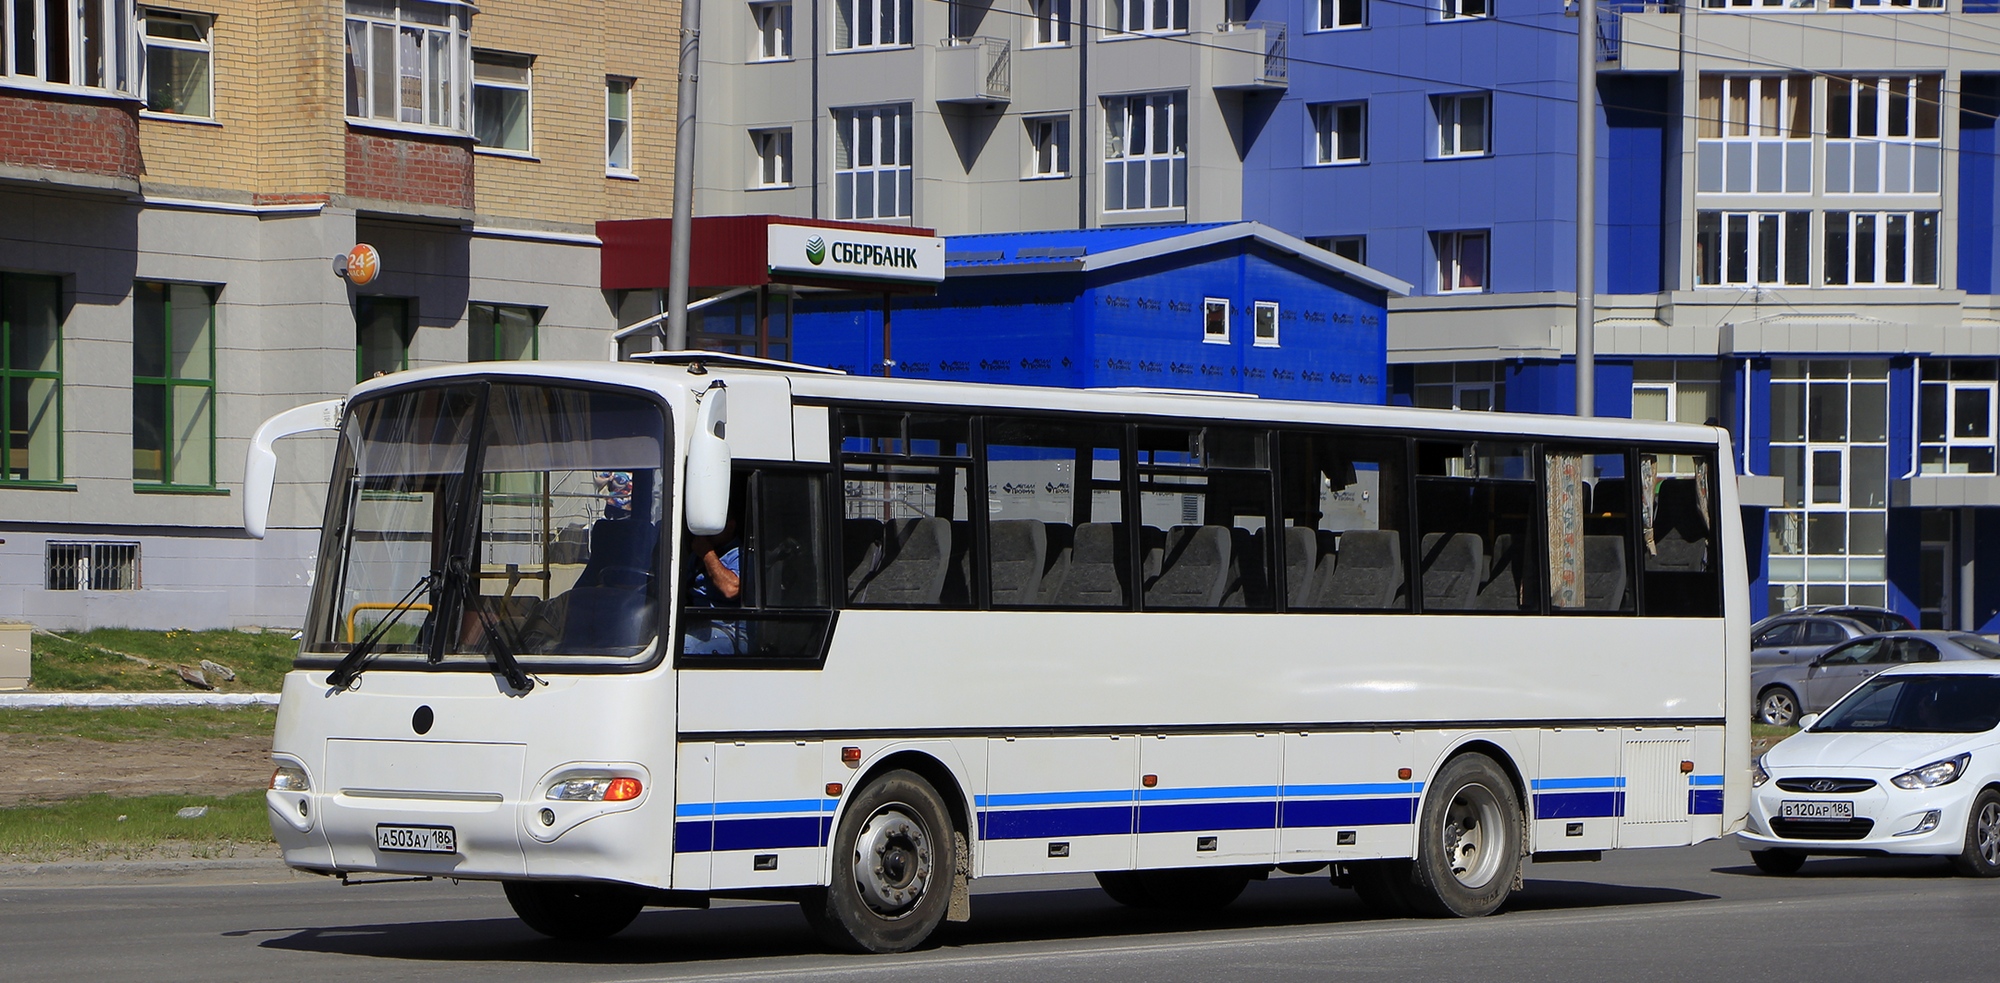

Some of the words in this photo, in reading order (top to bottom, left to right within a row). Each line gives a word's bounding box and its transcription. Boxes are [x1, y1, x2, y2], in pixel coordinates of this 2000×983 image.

[348, 253, 366, 269] 24
[831, 241, 918, 269] СБЕРБАНК
[1785, 803, 1830, 816] В120АР
[1832, 803, 1850, 813] 186
[382, 829, 429, 848] А503АУ
[432, 830, 451, 844] 186
